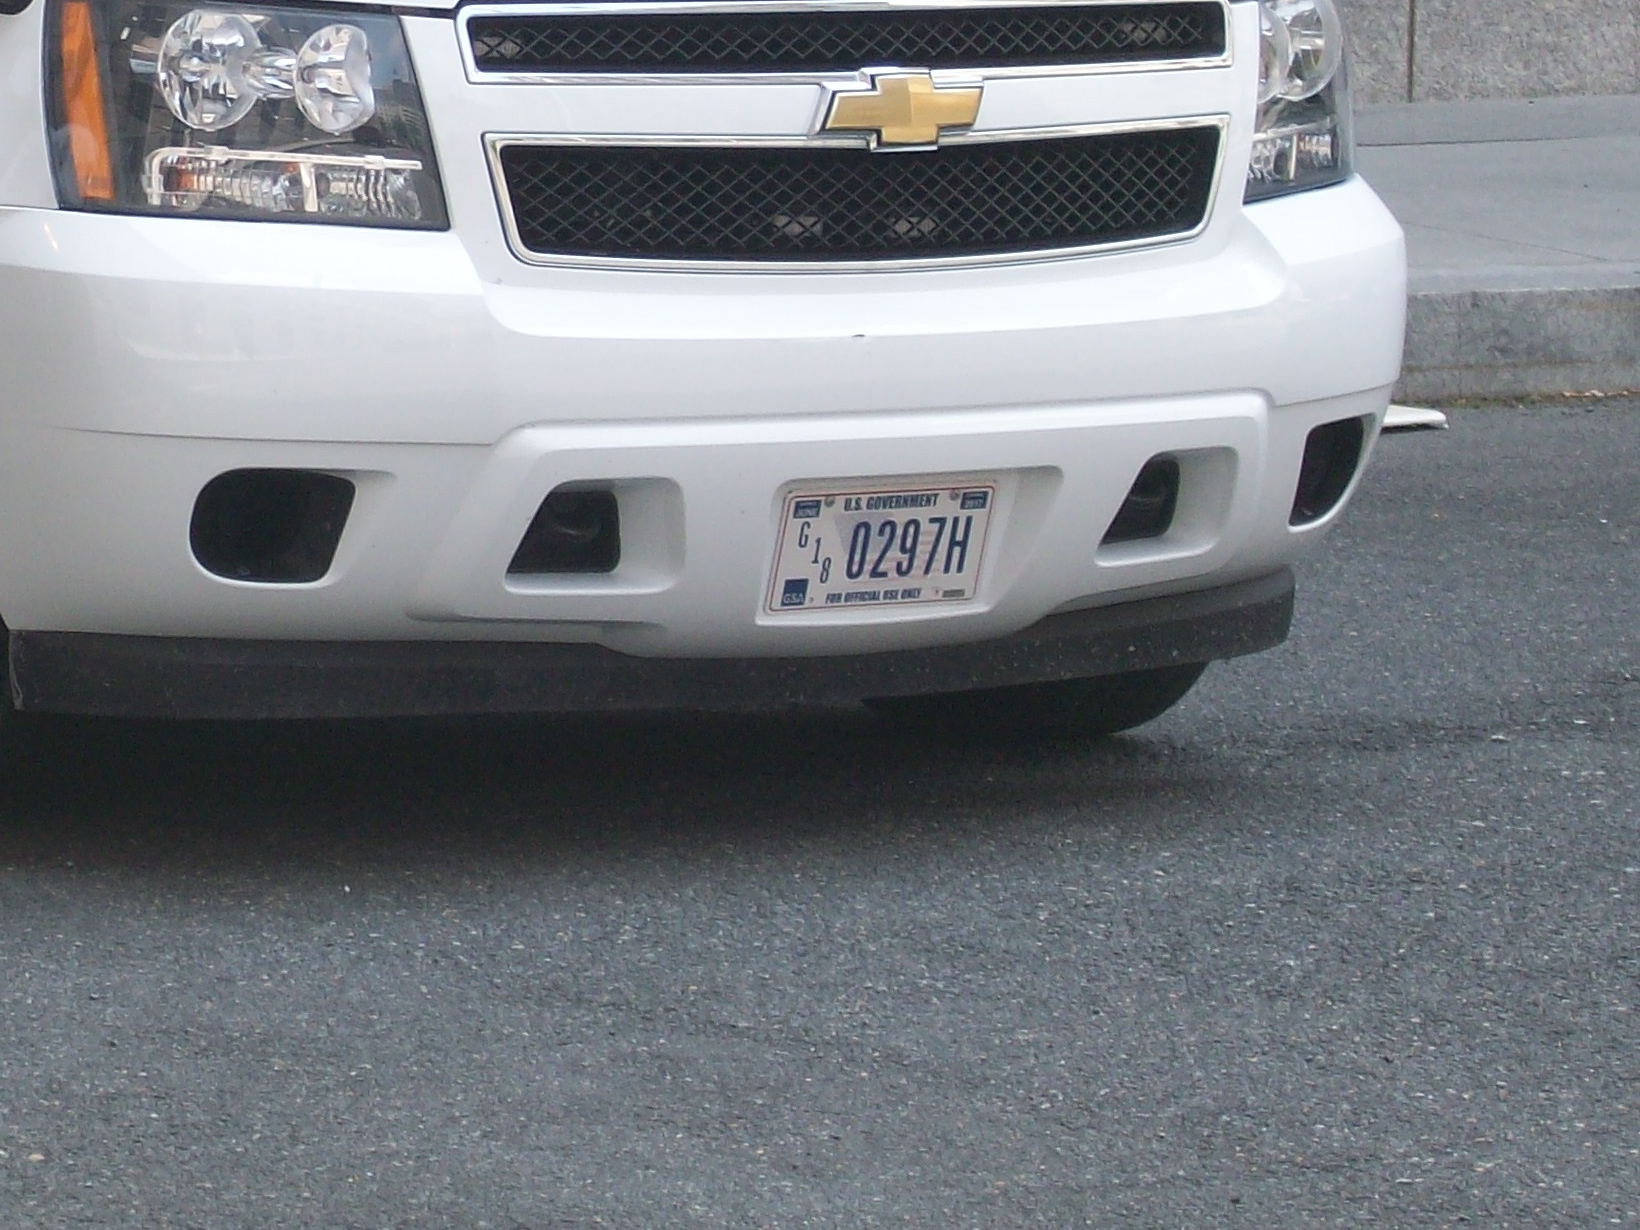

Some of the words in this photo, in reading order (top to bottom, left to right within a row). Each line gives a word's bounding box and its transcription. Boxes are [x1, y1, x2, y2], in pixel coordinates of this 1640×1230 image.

[843, 496, 864, 512] U.S.
[866, 492, 940, 511] GOVERNMENT
[845, 515, 973, 580] 0297H
[783, 592, 804, 605] GSA
[825, 593, 843, 605] FOR
[844, 590, 880, 604] OFFICIAL
[882, 589, 900, 601] USE
[901, 588, 922, 600] ONLY
